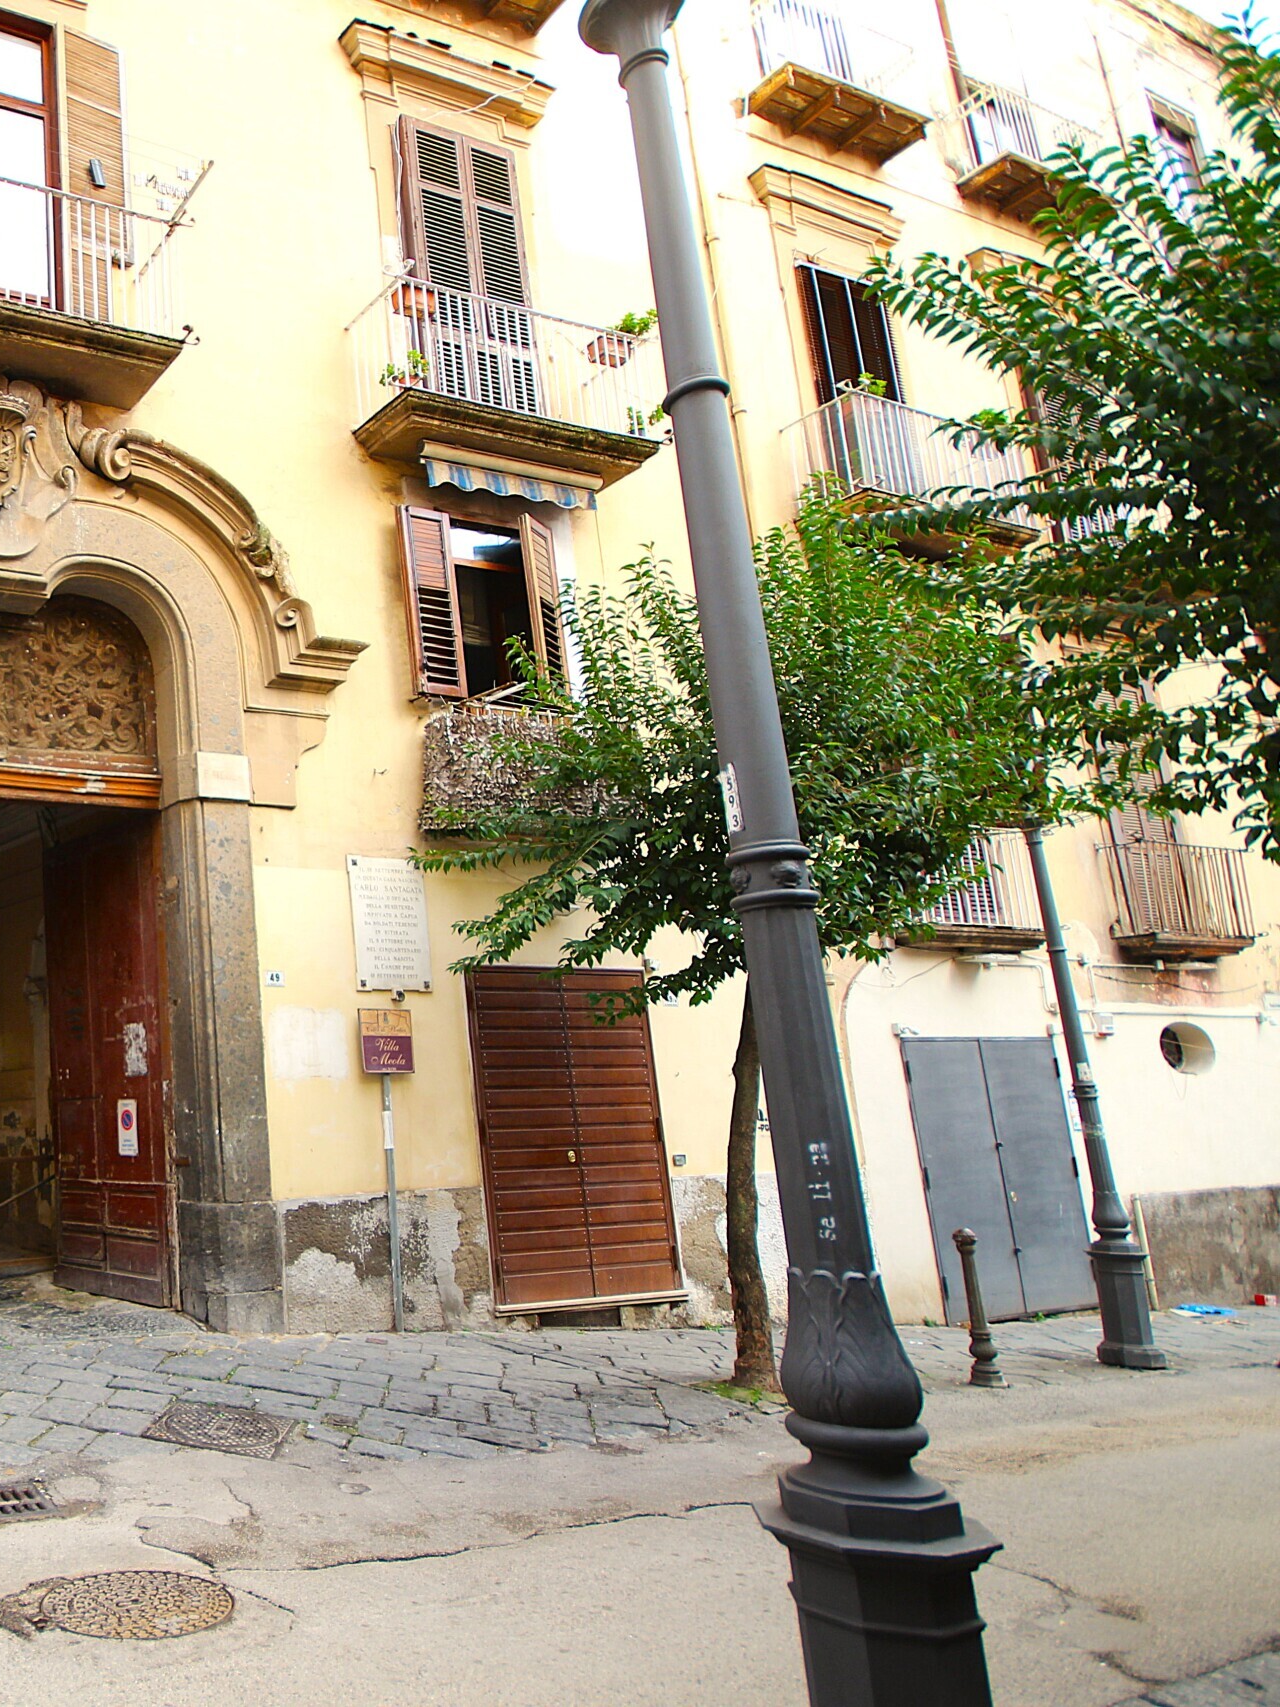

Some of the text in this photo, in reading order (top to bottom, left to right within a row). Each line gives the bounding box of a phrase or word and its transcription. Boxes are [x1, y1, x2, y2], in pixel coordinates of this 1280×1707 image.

[726, 777, 739, 828] 593
[354, 883, 423, 894] CARLO SANTAGATA
[270, 973, 280, 982] 49
[375, 1038, 400, 1051] Villa
[371, 1052, 407, 1065] Meola
